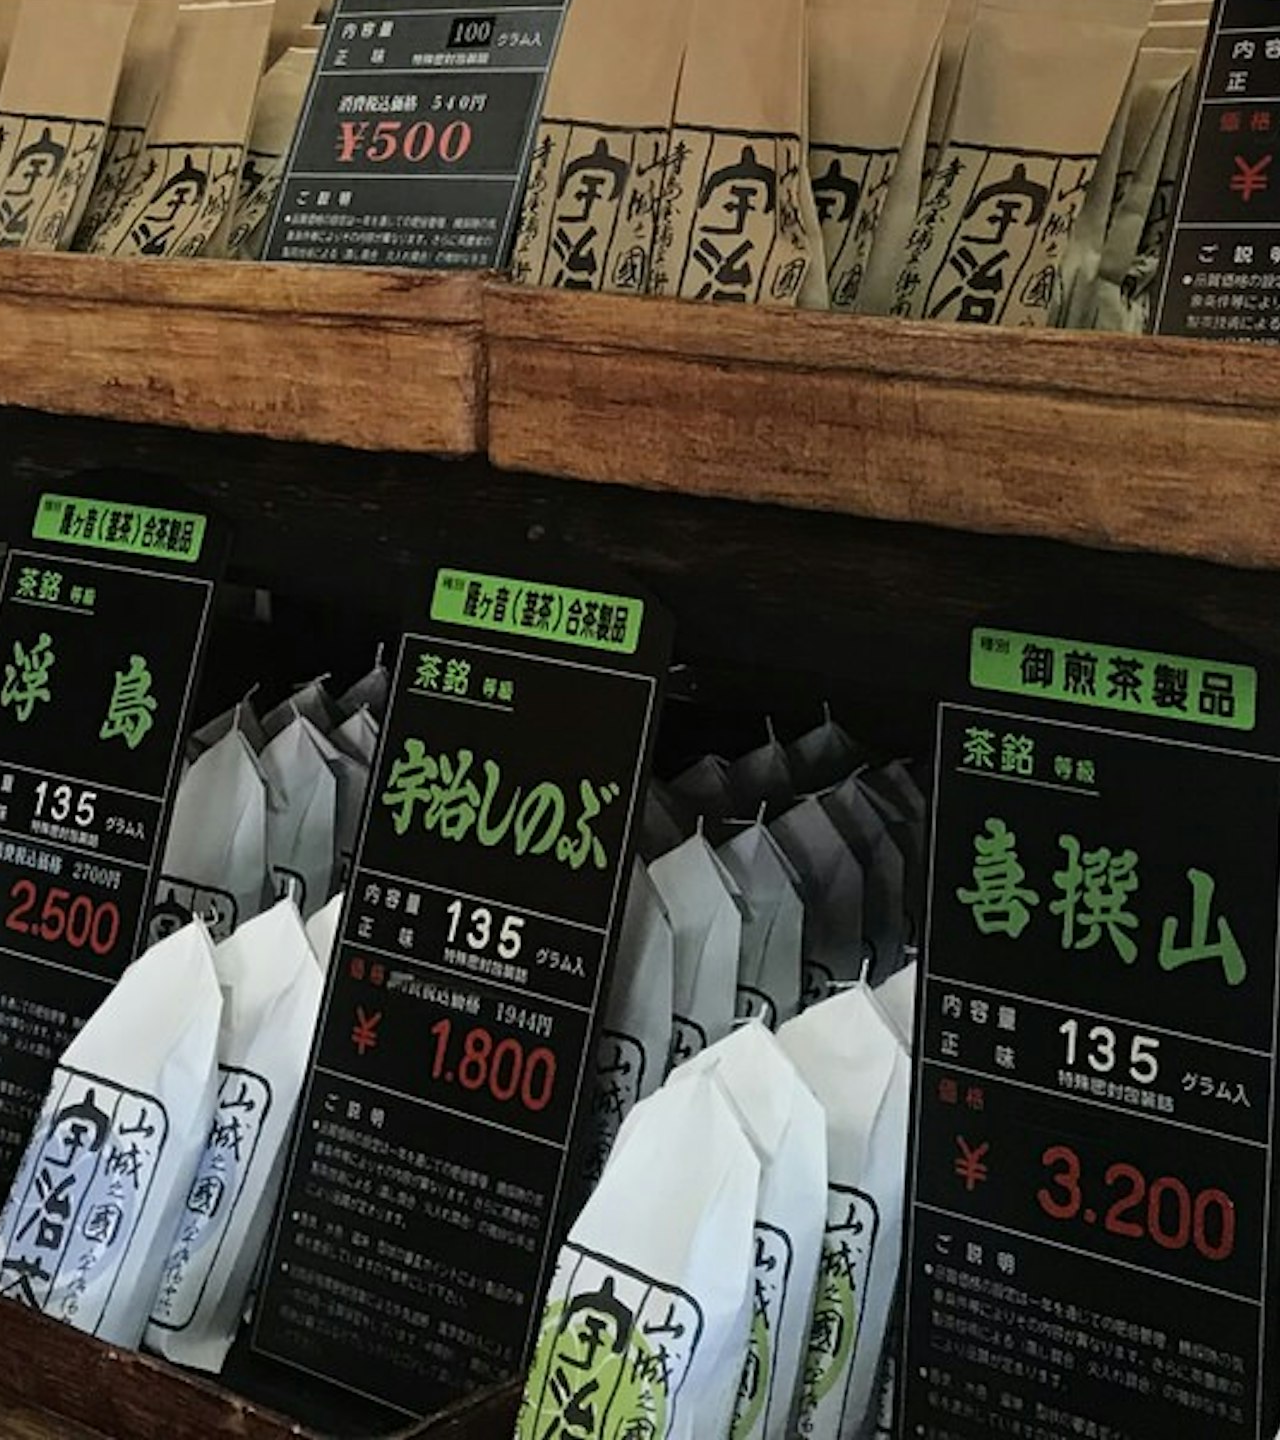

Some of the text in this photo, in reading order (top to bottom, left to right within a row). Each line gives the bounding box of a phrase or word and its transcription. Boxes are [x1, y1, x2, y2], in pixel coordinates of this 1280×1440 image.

[452, 23, 492, 44] 100
[336, 120, 473, 163] ¥500
[1228, 154, 1273, 202] ¥
[15, 567, 60, 602] 茶銘
[0, 632, 159, 750] 浮島
[415, 652, 472, 696] 茶銘
[1020, 643, 1236, 719] 御煎茶製品
[963, 726, 1097, 785] 茶銘 等級
[33, 782, 98, 827] 135
[382, 737, 620, 871] 宇治しのぶ
[957, 816, 1247, 987] 喜撰山
[362, 882, 587, 977] 内容量 135 グラム入
[351, 1006, 384, 1055] ¥
[494, 1001, 554, 1038] 1944円
[940, 1030, 1016, 1071] 正味
[943, 993, 1251, 1109] 内容量 135 グラム入
[953, 1135, 990, 1191] ¥
